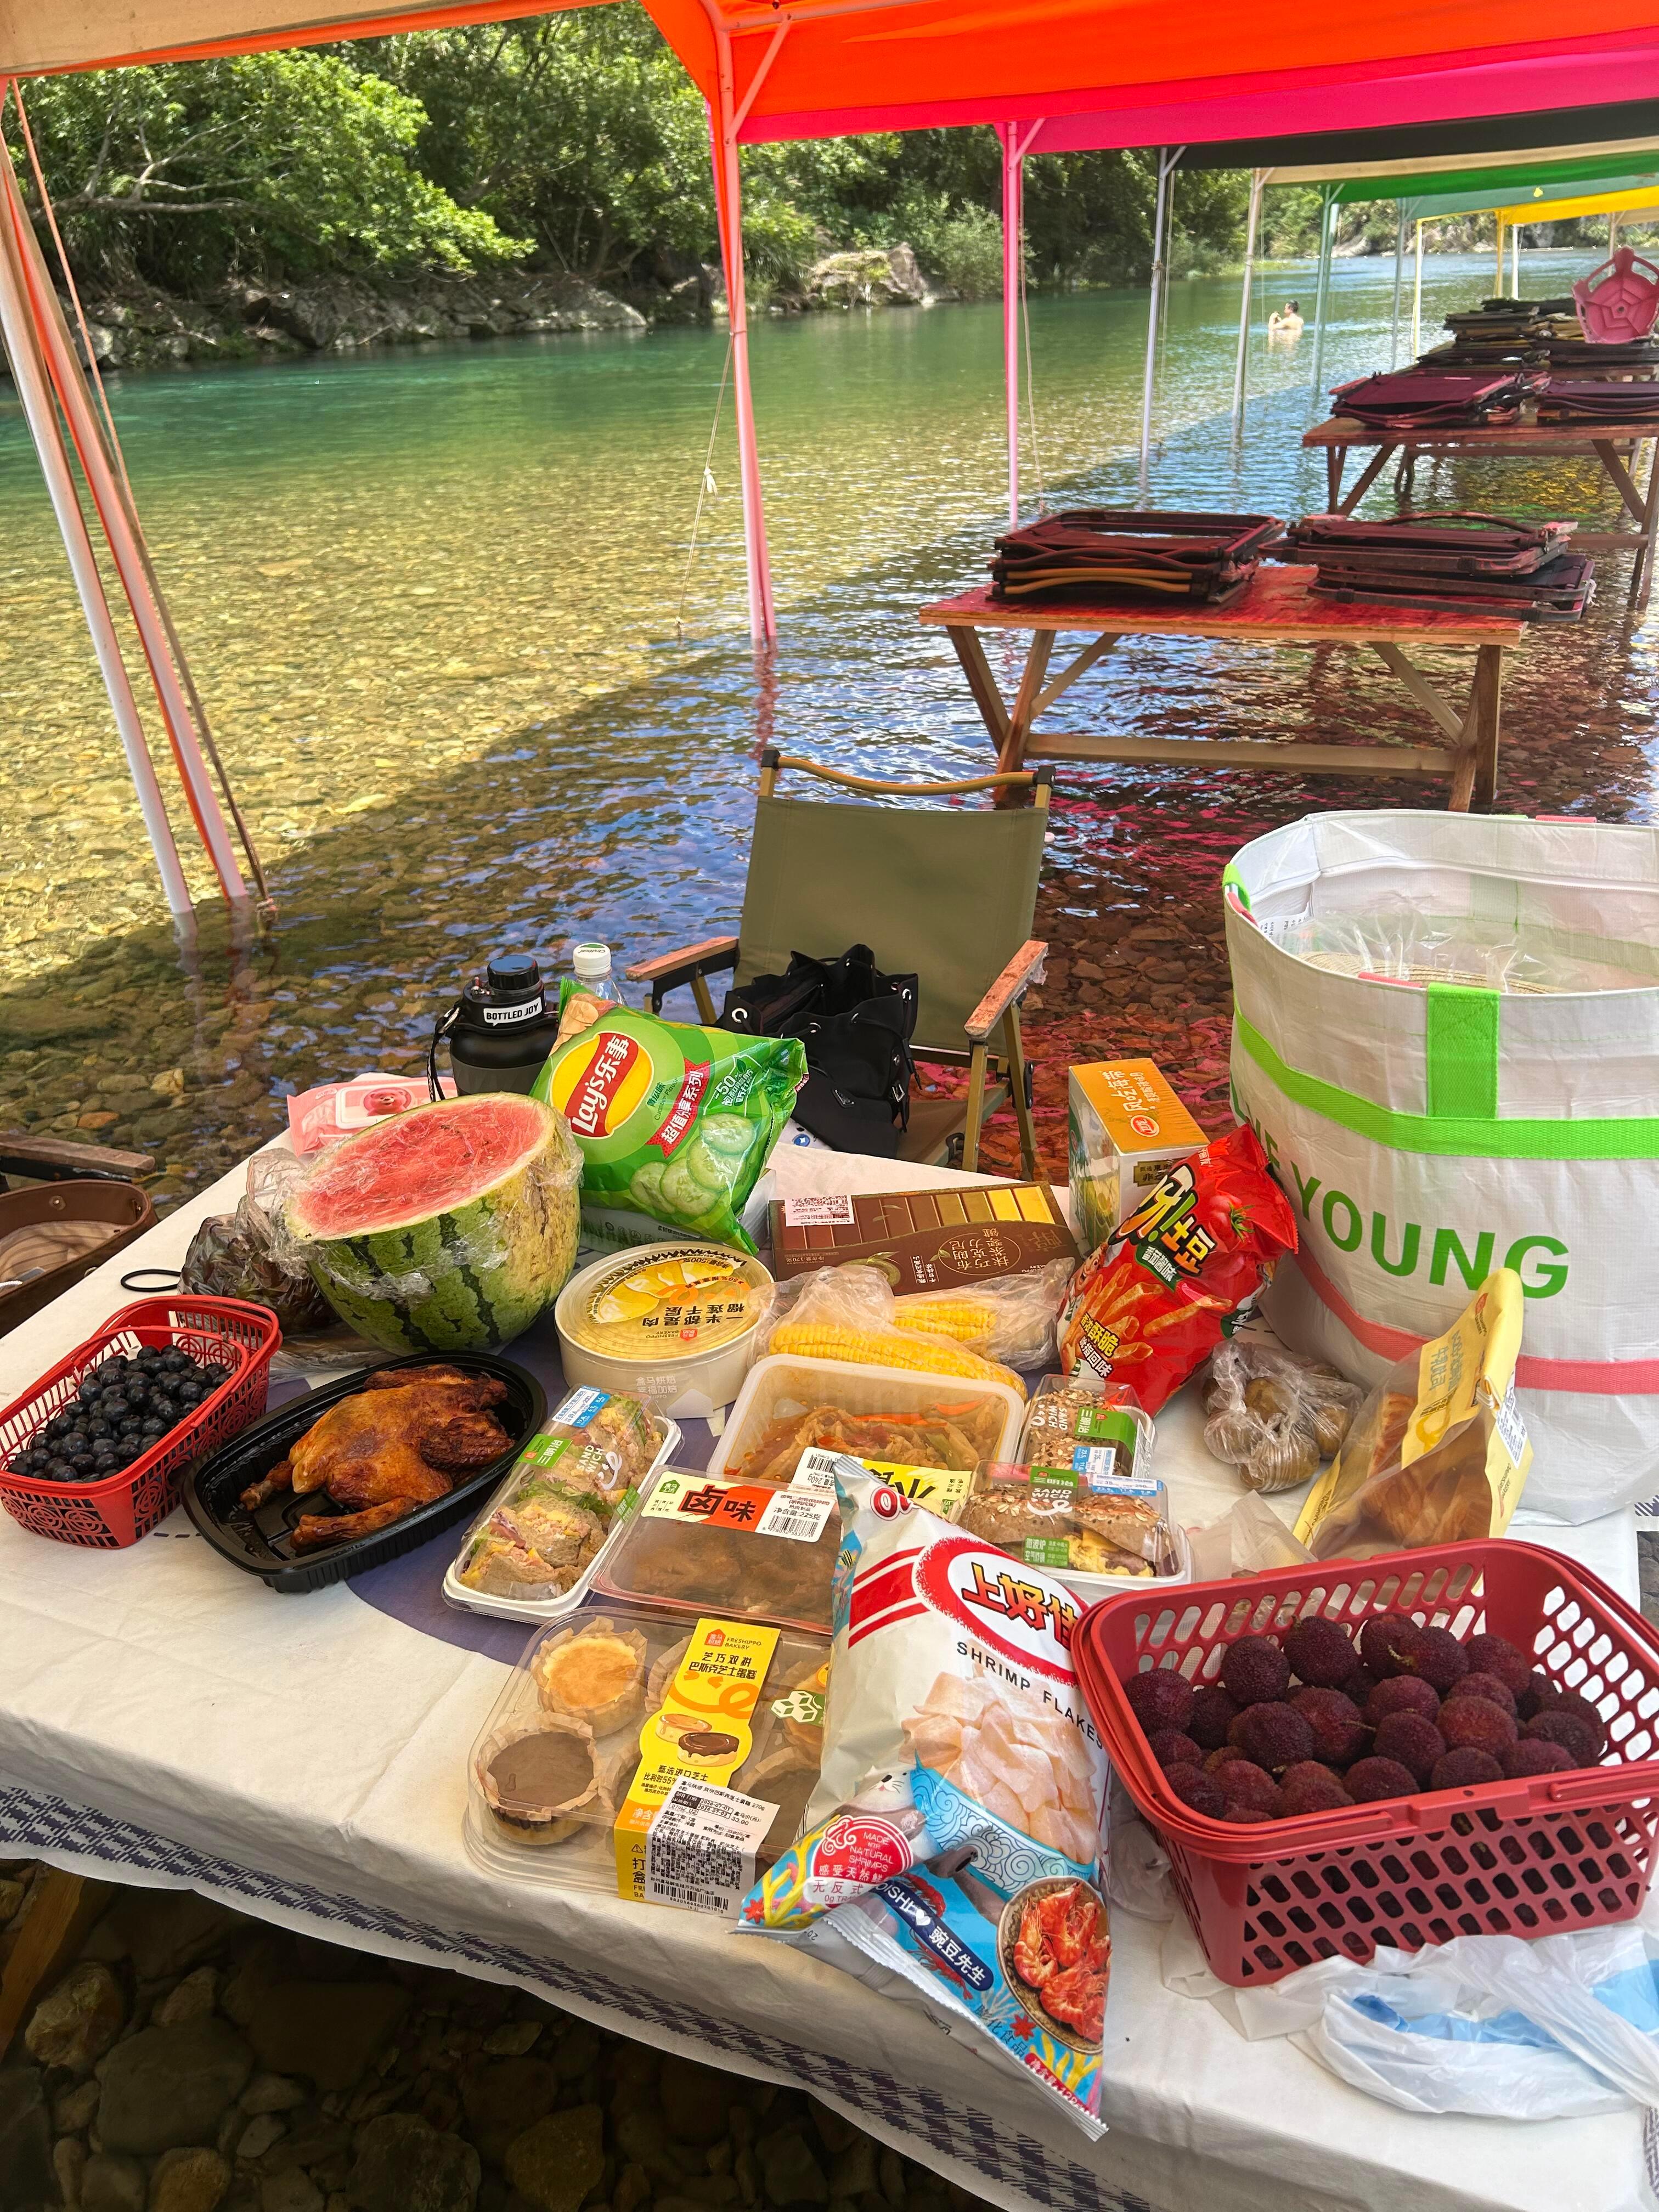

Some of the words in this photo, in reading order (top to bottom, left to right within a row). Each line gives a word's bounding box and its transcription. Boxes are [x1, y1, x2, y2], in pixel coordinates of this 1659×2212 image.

[486, 1010, 523, 1021] BOTTLED
[524, 1002, 539, 1014] JOY
[571, 1074, 606, 1135] Lay's
[595, 1035, 631, 1084] 乐事
[665, 1078, 679, 1097] Flavor
[661, 1070, 704, 1144] 超值分享系列
[981, 1227, 1009, 1267] 抹茶琴键
[1296, 1175, 1571, 1299] YOUNG
[948, 1240, 973, 1271] 布朗尼
[969, 1238, 989, 1269] 巧克力
[1142, 1246, 1177, 1282] 番茄酱味
[665, 1303, 744, 1316] 榴莲千层
[642, 1315, 743, 1327] 一半都是肉
[636, 1375, 676, 1385] 盒马烘焙
[1048, 1406, 1058, 1428] WICH
[1058, 1407, 1068, 1430] SAND
[1077, 1409, 1092, 1434] 三明治
[537, 1439, 564, 1465] 三明治
[575, 1444, 595, 1472] SAND
[585, 1448, 605, 1474] WICH
[1034, 1477, 1073, 1487] 三明治
[680, 1486, 757, 1522] 卤味
[962, 1562, 1079, 1651] 上好佳
[727, 1637, 761, 1646] FRESHIPPO
[702, 1651, 752, 1667] 芝巧双拼
[689, 1661, 757, 1680] 巴斯克芝士蛋糕
[957, 1641, 1031, 1691] SHRIMP
[1043, 1689, 1104, 1750] FLAKES
[658, 1765, 708, 1781] 甄选进口芝士
[632, 1808, 654, 1820] 净含
[863, 1832, 890, 1846] MADE
[849, 1855, 888, 1872] SHRIMPS
[850, 1846, 894, 1864] NATURAL
[813, 1880, 864, 1895] 无反式
[929, 1925, 985, 1986] 豌豆先生
